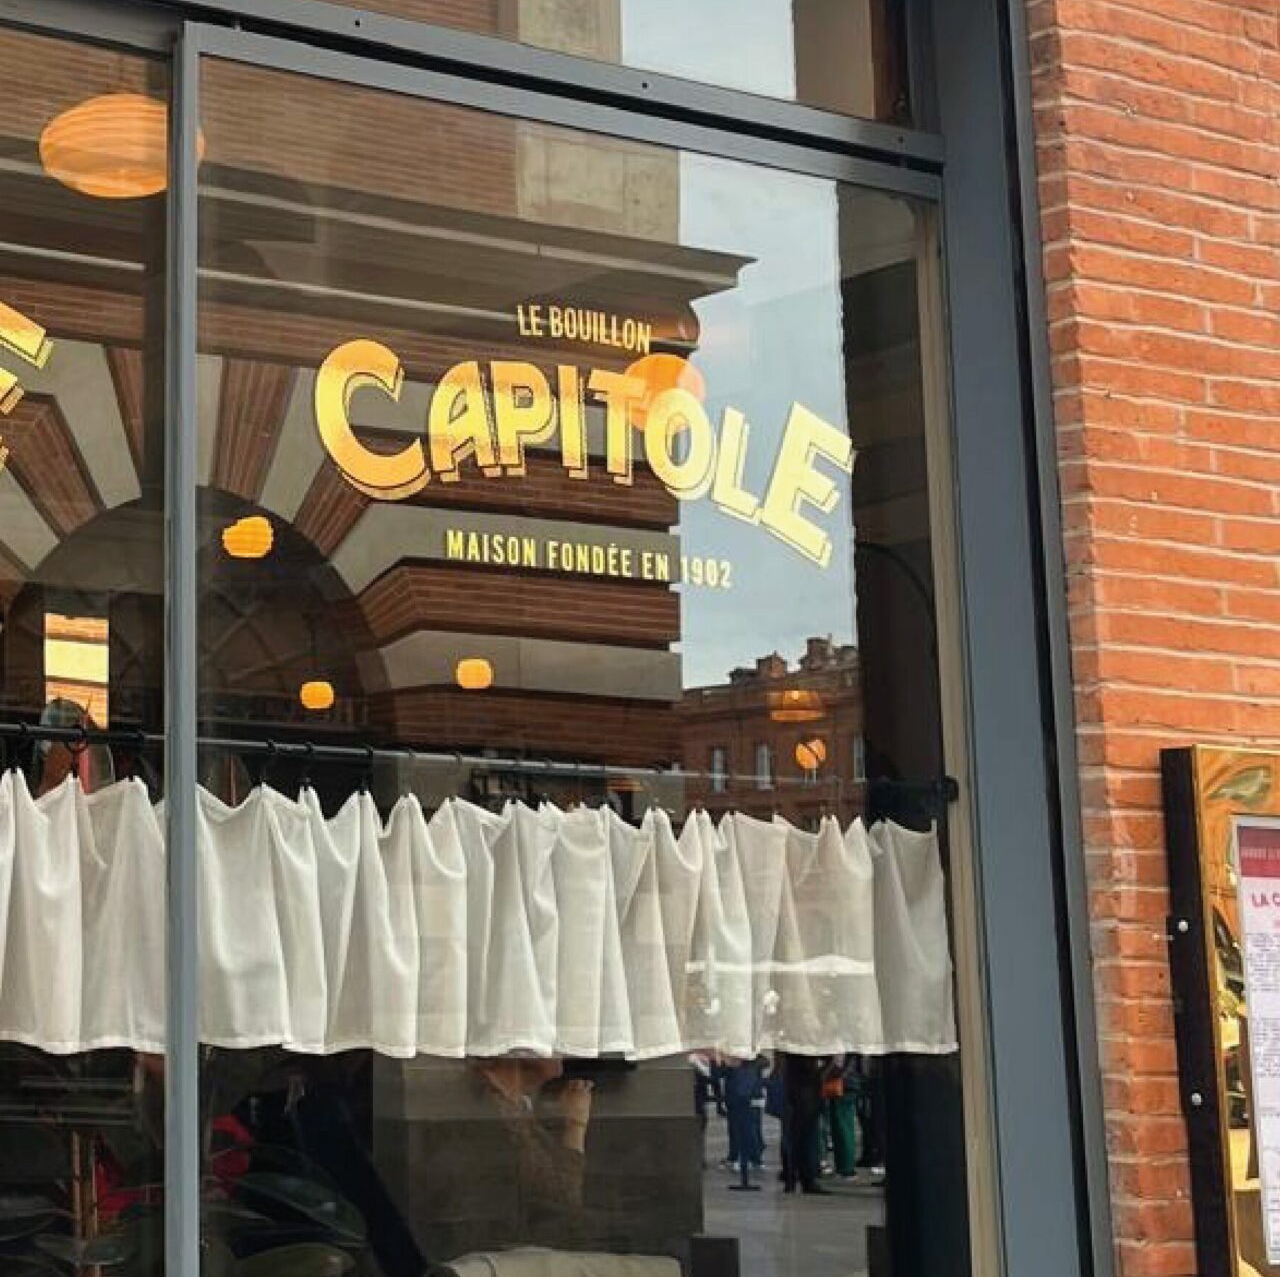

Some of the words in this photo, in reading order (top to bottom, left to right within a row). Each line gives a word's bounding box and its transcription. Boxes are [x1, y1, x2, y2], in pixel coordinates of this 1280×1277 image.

[517, 304, 543, 336] LE
[549, 305, 652, 355] BOUILLON
[314, 338, 855, 569] CAPITOLE
[445, 529, 537, 567] MAISON
[548, 539, 633, 578] FONDÉE
[641, 551, 670, 581] EN
[680, 556, 733, 589] 1902
